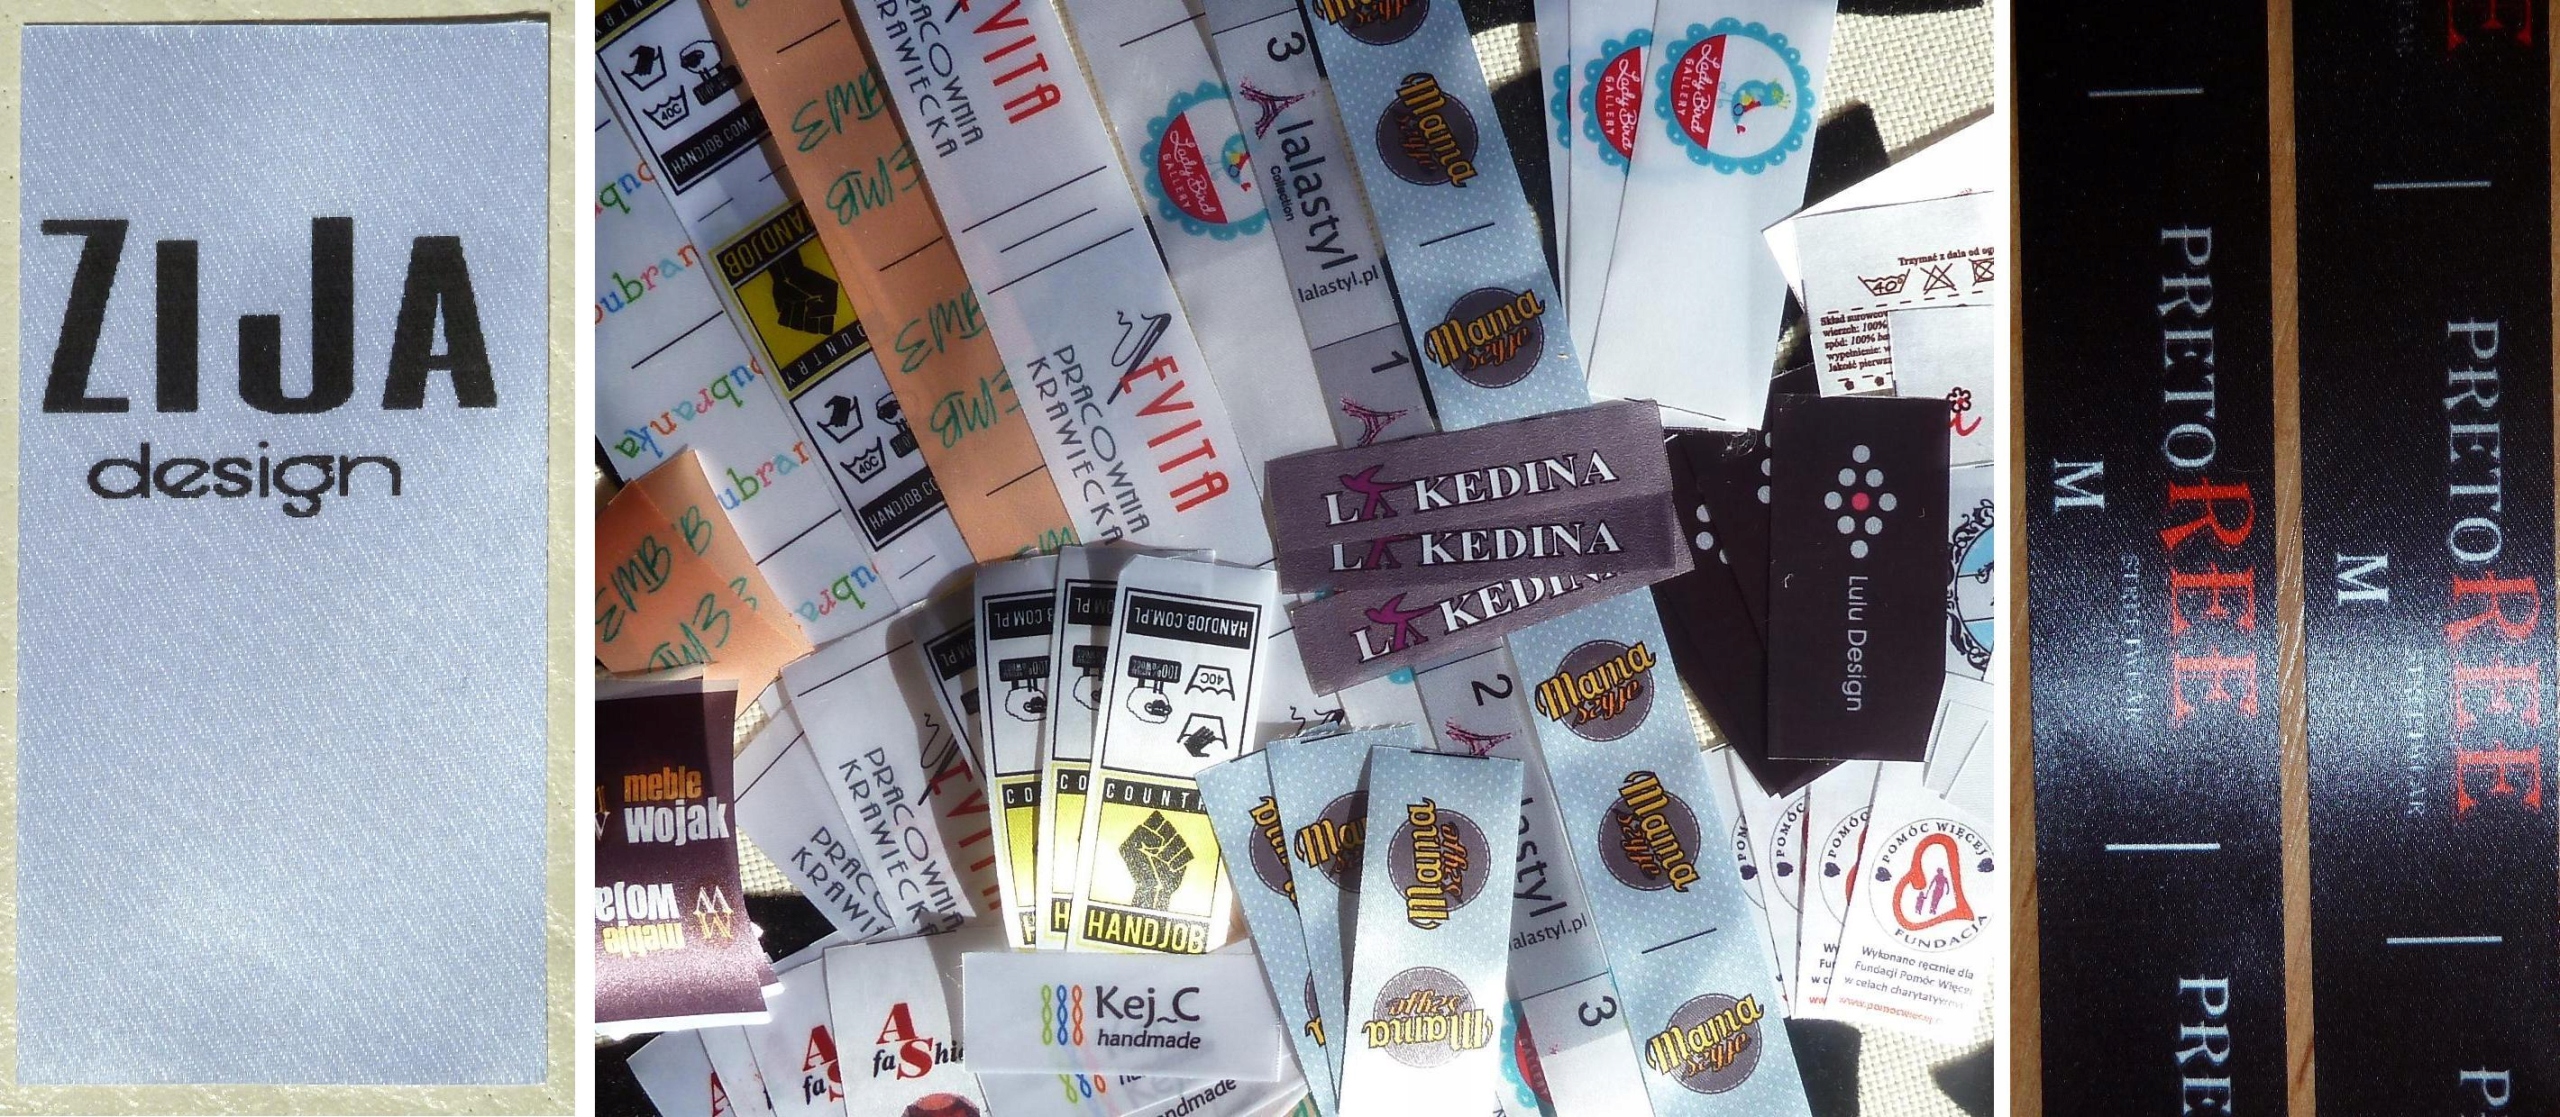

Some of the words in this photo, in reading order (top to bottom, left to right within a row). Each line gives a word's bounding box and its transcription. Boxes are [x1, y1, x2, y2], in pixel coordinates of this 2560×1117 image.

[960, 0, 1061, 124] VITA
[1267, 31, 1306, 62] 3
[1692, 44, 1720, 94] Lady
[873, 0, 958, 158] RAWIECKA
[905, 0, 984, 146] RACOWNIA
[1615, 59, 1640, 107] Lady
[1677, 58, 1694, 115] GALLERY
[661, 103, 682, 121] 40C
[1396, 72, 1478, 188] Mama
[1605, 76, 1615, 135] GALLERY
[1691, 94, 1711, 134] Bird
[1162, 153, 1191, 209] GALLERY
[1168, 130, 1196, 187] Lady
[1189, 174, 1218, 216] Bird
[1270, 165, 1296, 222] collection
[1277, 119, 1358, 271] lalastyl
[723, 206, 809, 278] ANDJOB
[1898, 252, 1938, 267] Trzymać
[1947, 249, 1966, 259] dala
[1969, 247, 1979, 256] od
[1298, 265, 1379, 303] lalastyl.pl
[41, 216, 498, 414] ZIJA
[1424, 289, 1546, 369] Mama
[1820, 316, 1846, 327] Skład
[1371, 350, 1409, 374] 1
[1825, 339, 1848, 351] spód:
[1851, 335, 1876, 346] 100%
[1828, 360, 1857, 372] Jakość
[1027, 356, 1124, 545] KRAWIECKA
[1053, 345, 1150, 534] PRACOWNIA
[1119, 356, 1229, 512] EVITA
[88, 441, 402, 518] design
[859, 455, 879, 474] 40C
[1413, 450, 1619, 514] KEDINA
[2053, 457, 2105, 512] M
[1418, 520, 1625, 567] KEDINA
[1848, 575, 1869, 621] Lulu
[2337, 551, 2389, 606] M
[1135, 606, 1249, 638] HANDJOB.COM.PL
[1200, 673, 1225, 686] 40C
[1471, 673, 1513, 706] 2
[1535, 640, 1656, 722] Mama
[1842, 629, 1868, 712] Design
[1570, 681, 1642, 729] szyje
[623, 766, 702, 802] meble
[624, 797, 729, 846] wojak
[1612, 808, 1662, 881] szyje
[1618, 770, 1701, 893] Mama
[1882, 822, 1930, 864] POMÓC
[1936, 820, 1989, 856] WIĘCEJ
[1405, 797, 1449, 929] Mama
[602, 922, 686, 958] meble
[1087, 907, 1206, 954] HANDJOB
[1894, 914, 1988, 949] FUNDACJA
[1361, 1008, 1493, 1052] Mama
[1578, 995, 1618, 1027] 3
[1645, 993, 1764, 1076] Mama
[1097, 1029, 1201, 1050] handmade
[1683, 1033, 1748, 1080] szyje
